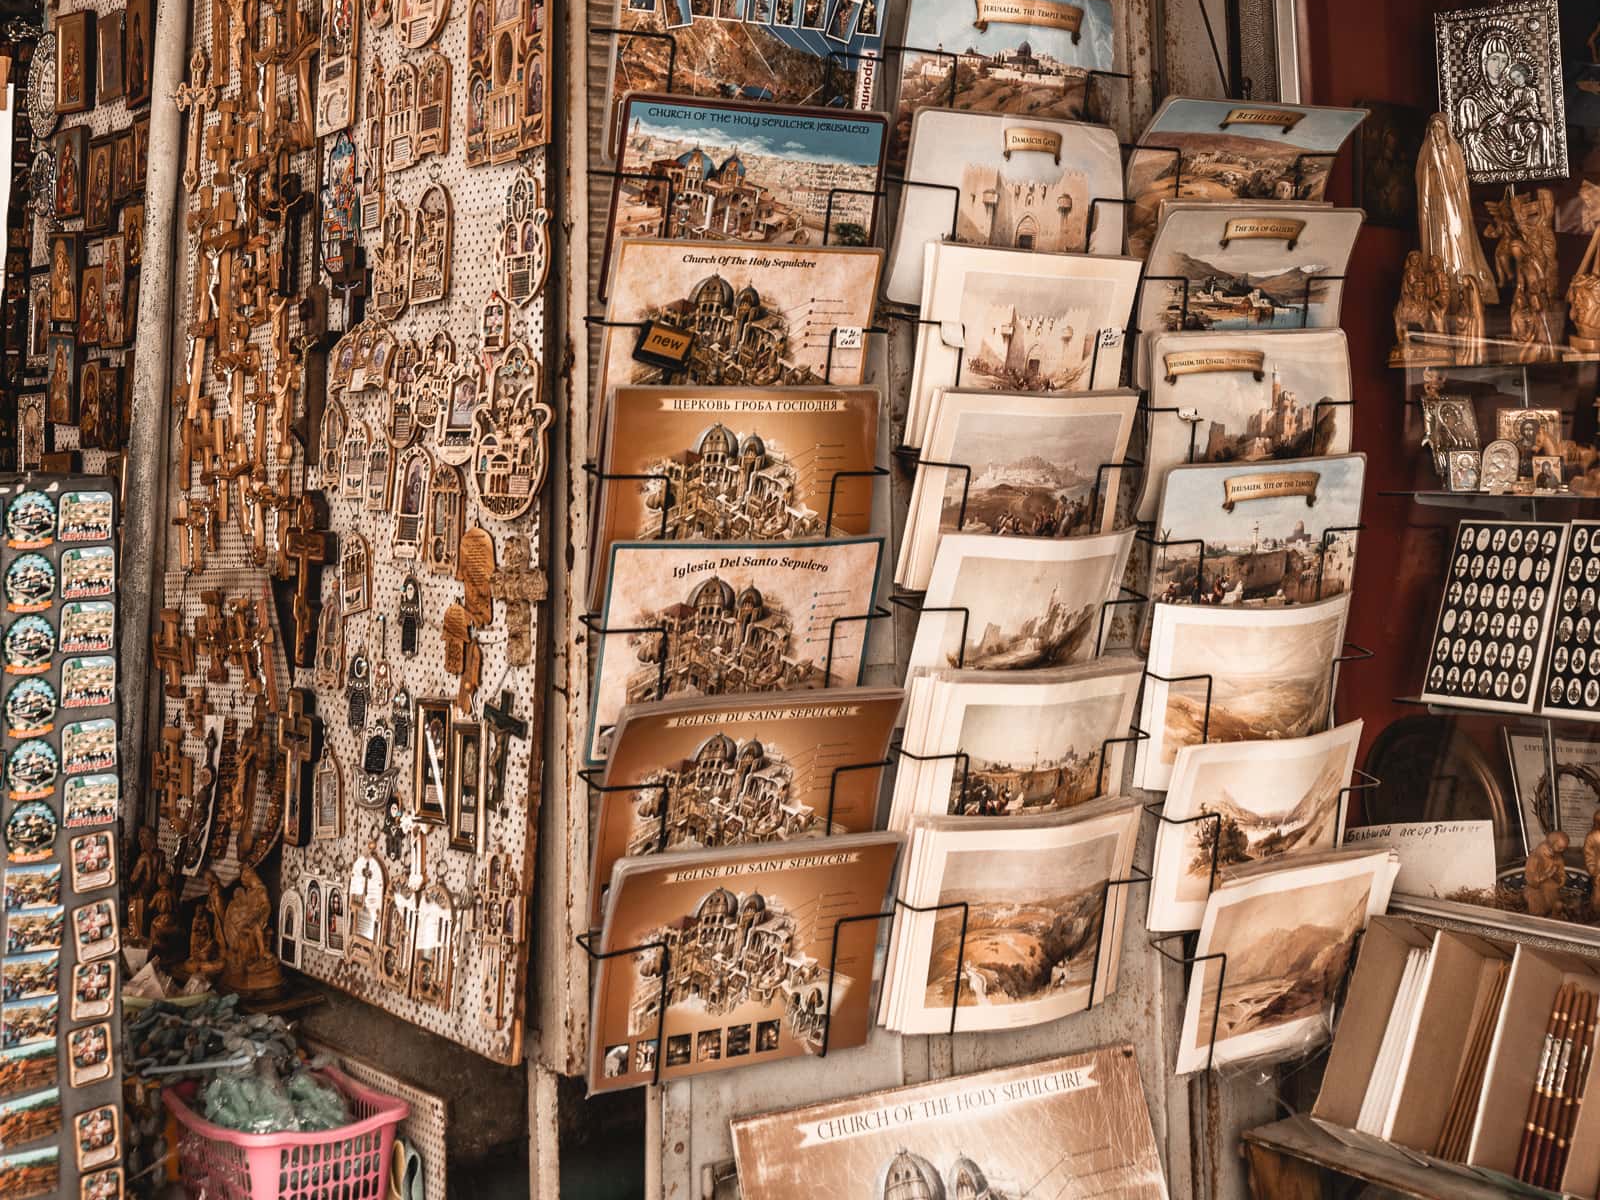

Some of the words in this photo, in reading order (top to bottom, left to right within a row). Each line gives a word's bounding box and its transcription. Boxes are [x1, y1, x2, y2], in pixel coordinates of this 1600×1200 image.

[648, 107, 691, 120] CHURCH
[693, 111, 708, 121] OF
[709, 113, 731, 123] THE
[733, 115, 759, 128] HOLY
[682, 254, 717, 265] Church
[718, 256, 730, 266] Of
[730, 256, 747, 265] The
[749, 257, 771, 267] Holy
[772, 259, 817, 268] Sepulchre
[652, 335, 684, 350] new
[673, 400, 730, 412] ЦЕРКОВЬ
[734, 400, 773, 411] ГРОБА
[776, 400, 838, 412] ГОСПОДНЯ
[673, 560, 716, 578] Iglesia
[719, 556, 740, 569] Del
[742, 556, 778, 567] Santo
[780, 557, 829, 573] Sepulcro
[726, 711, 744, 722] DU
[748, 709, 784, 721] SAINT
[726, 864, 744, 875] DU
[748, 859, 784, 873] SAINT
[817, 1109, 889, 1139] CHURCH
[894, 1103, 915, 1123] OF
[919, 1095, 953, 1117] THE
[956, 1087, 997, 1112] HOLY
[1002, 1070, 1084, 1101] SEPULCHRE
